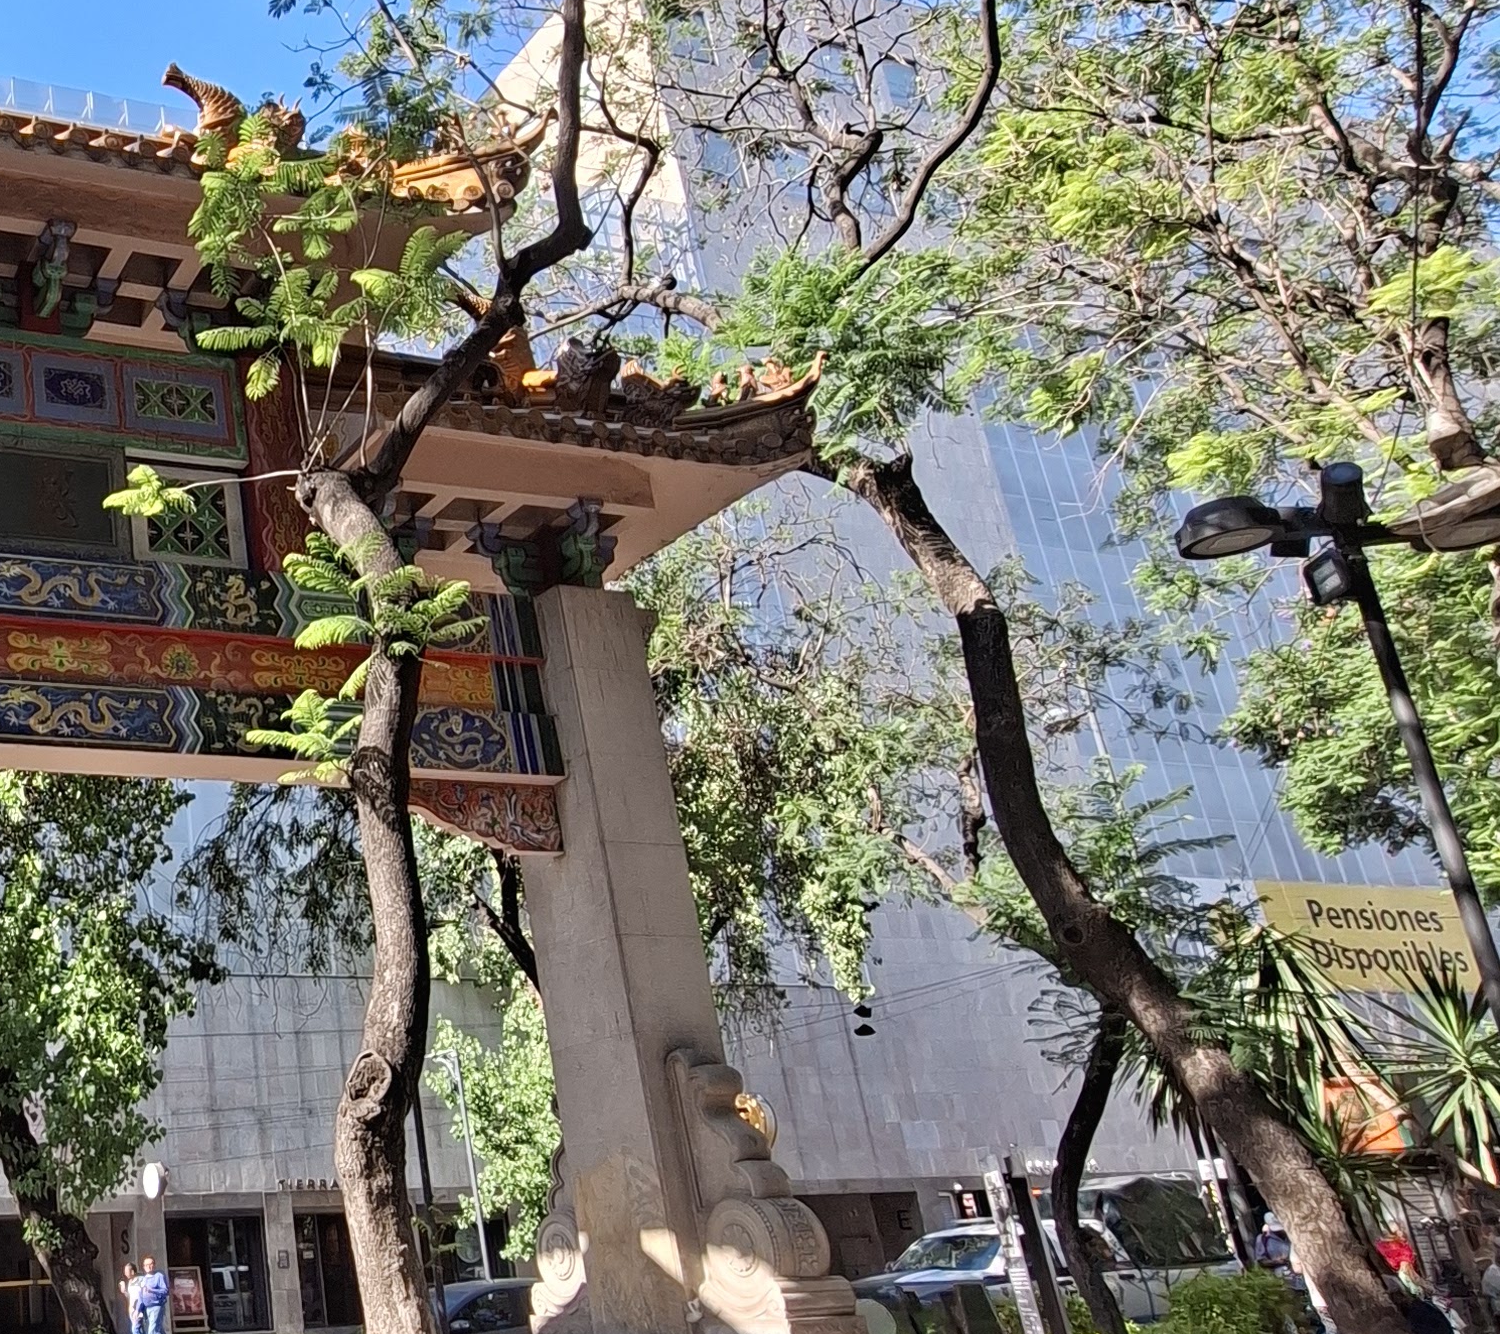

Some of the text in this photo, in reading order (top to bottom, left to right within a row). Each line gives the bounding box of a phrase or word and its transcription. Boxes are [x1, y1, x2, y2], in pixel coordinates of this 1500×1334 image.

[1306, 899, 1444, 933] Pensiones
[1310, 938, 1469, 978] Disponibles
[278, 1178, 340, 1191] TIERRA
[896, 1209, 913, 1231] E
[120, 1228, 131, 1255] S
